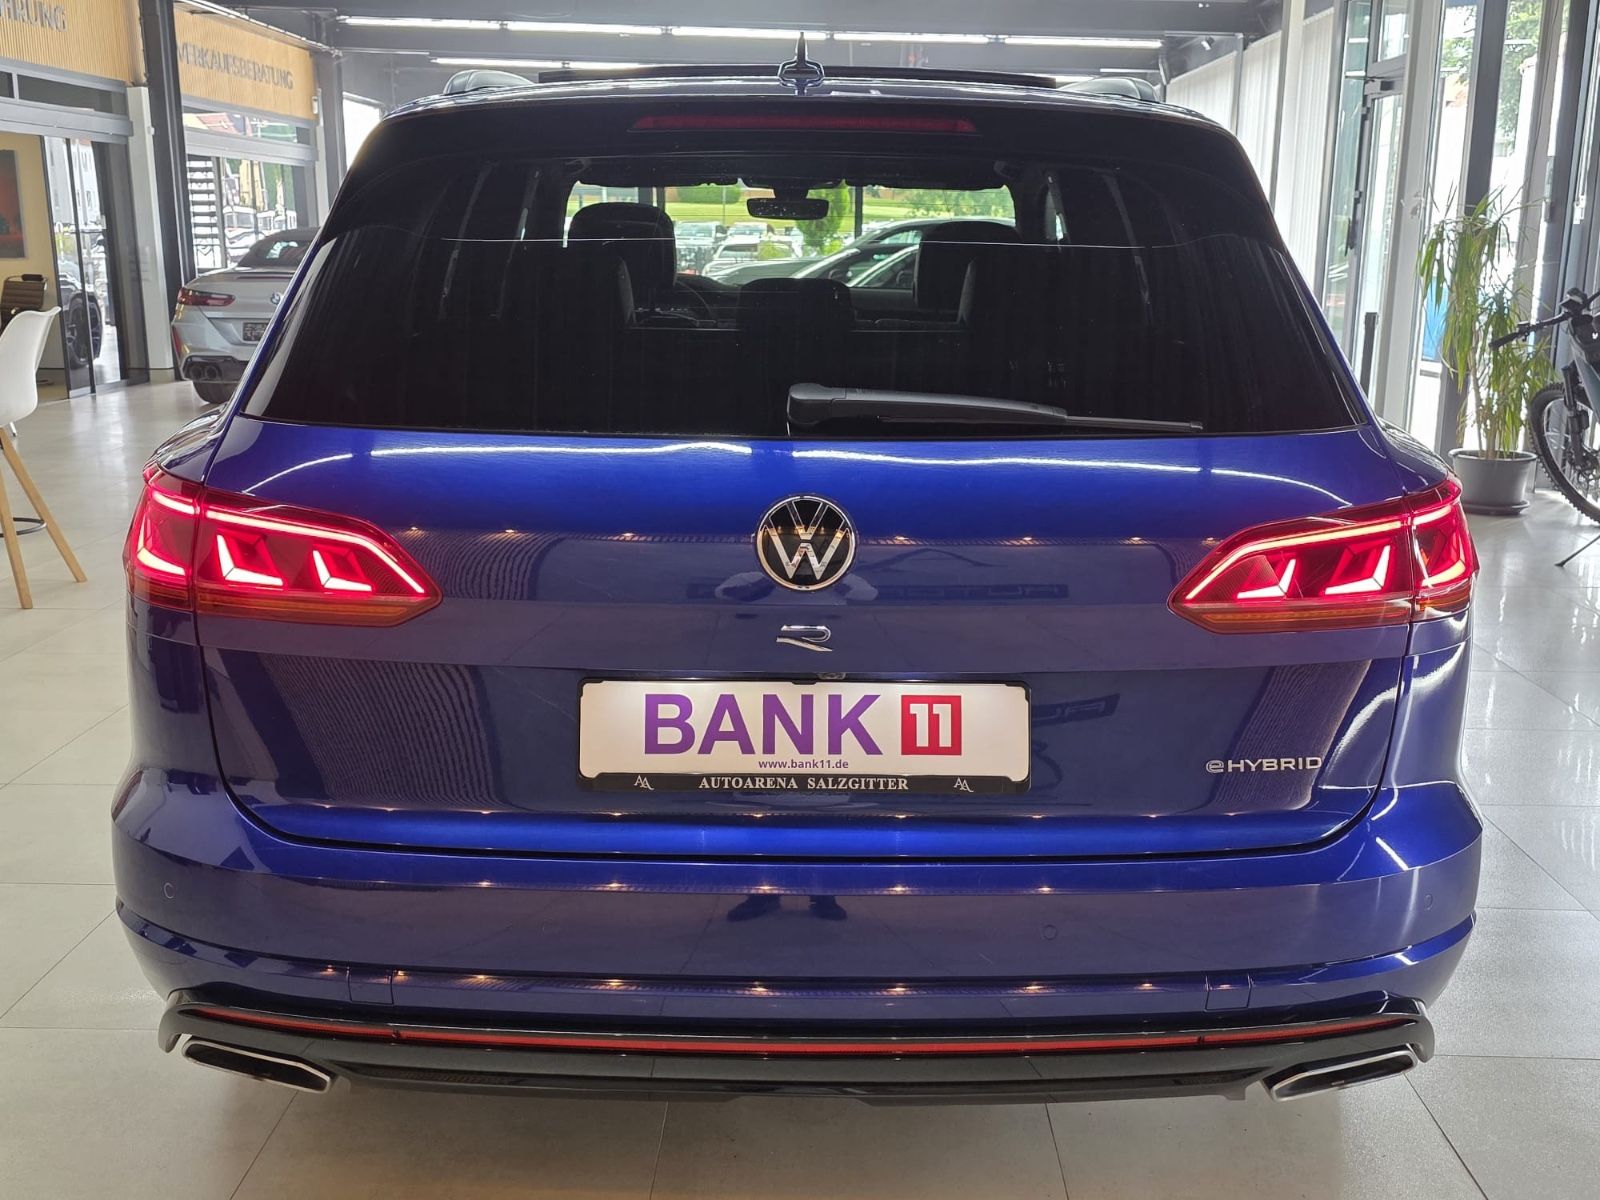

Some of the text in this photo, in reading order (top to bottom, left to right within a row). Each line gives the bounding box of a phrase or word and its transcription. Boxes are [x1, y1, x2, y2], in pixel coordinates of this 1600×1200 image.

[0, 0, 67, 32] HRUNG
[644, 693, 953, 756] BANK 11
[758, 759, 849, 769] www.bank11.de
[1205, 756, 1322, 774] eHYBRID
[698, 776, 799, 790] AUTOARENA
[807, 777, 909, 790] SALZGITTER
